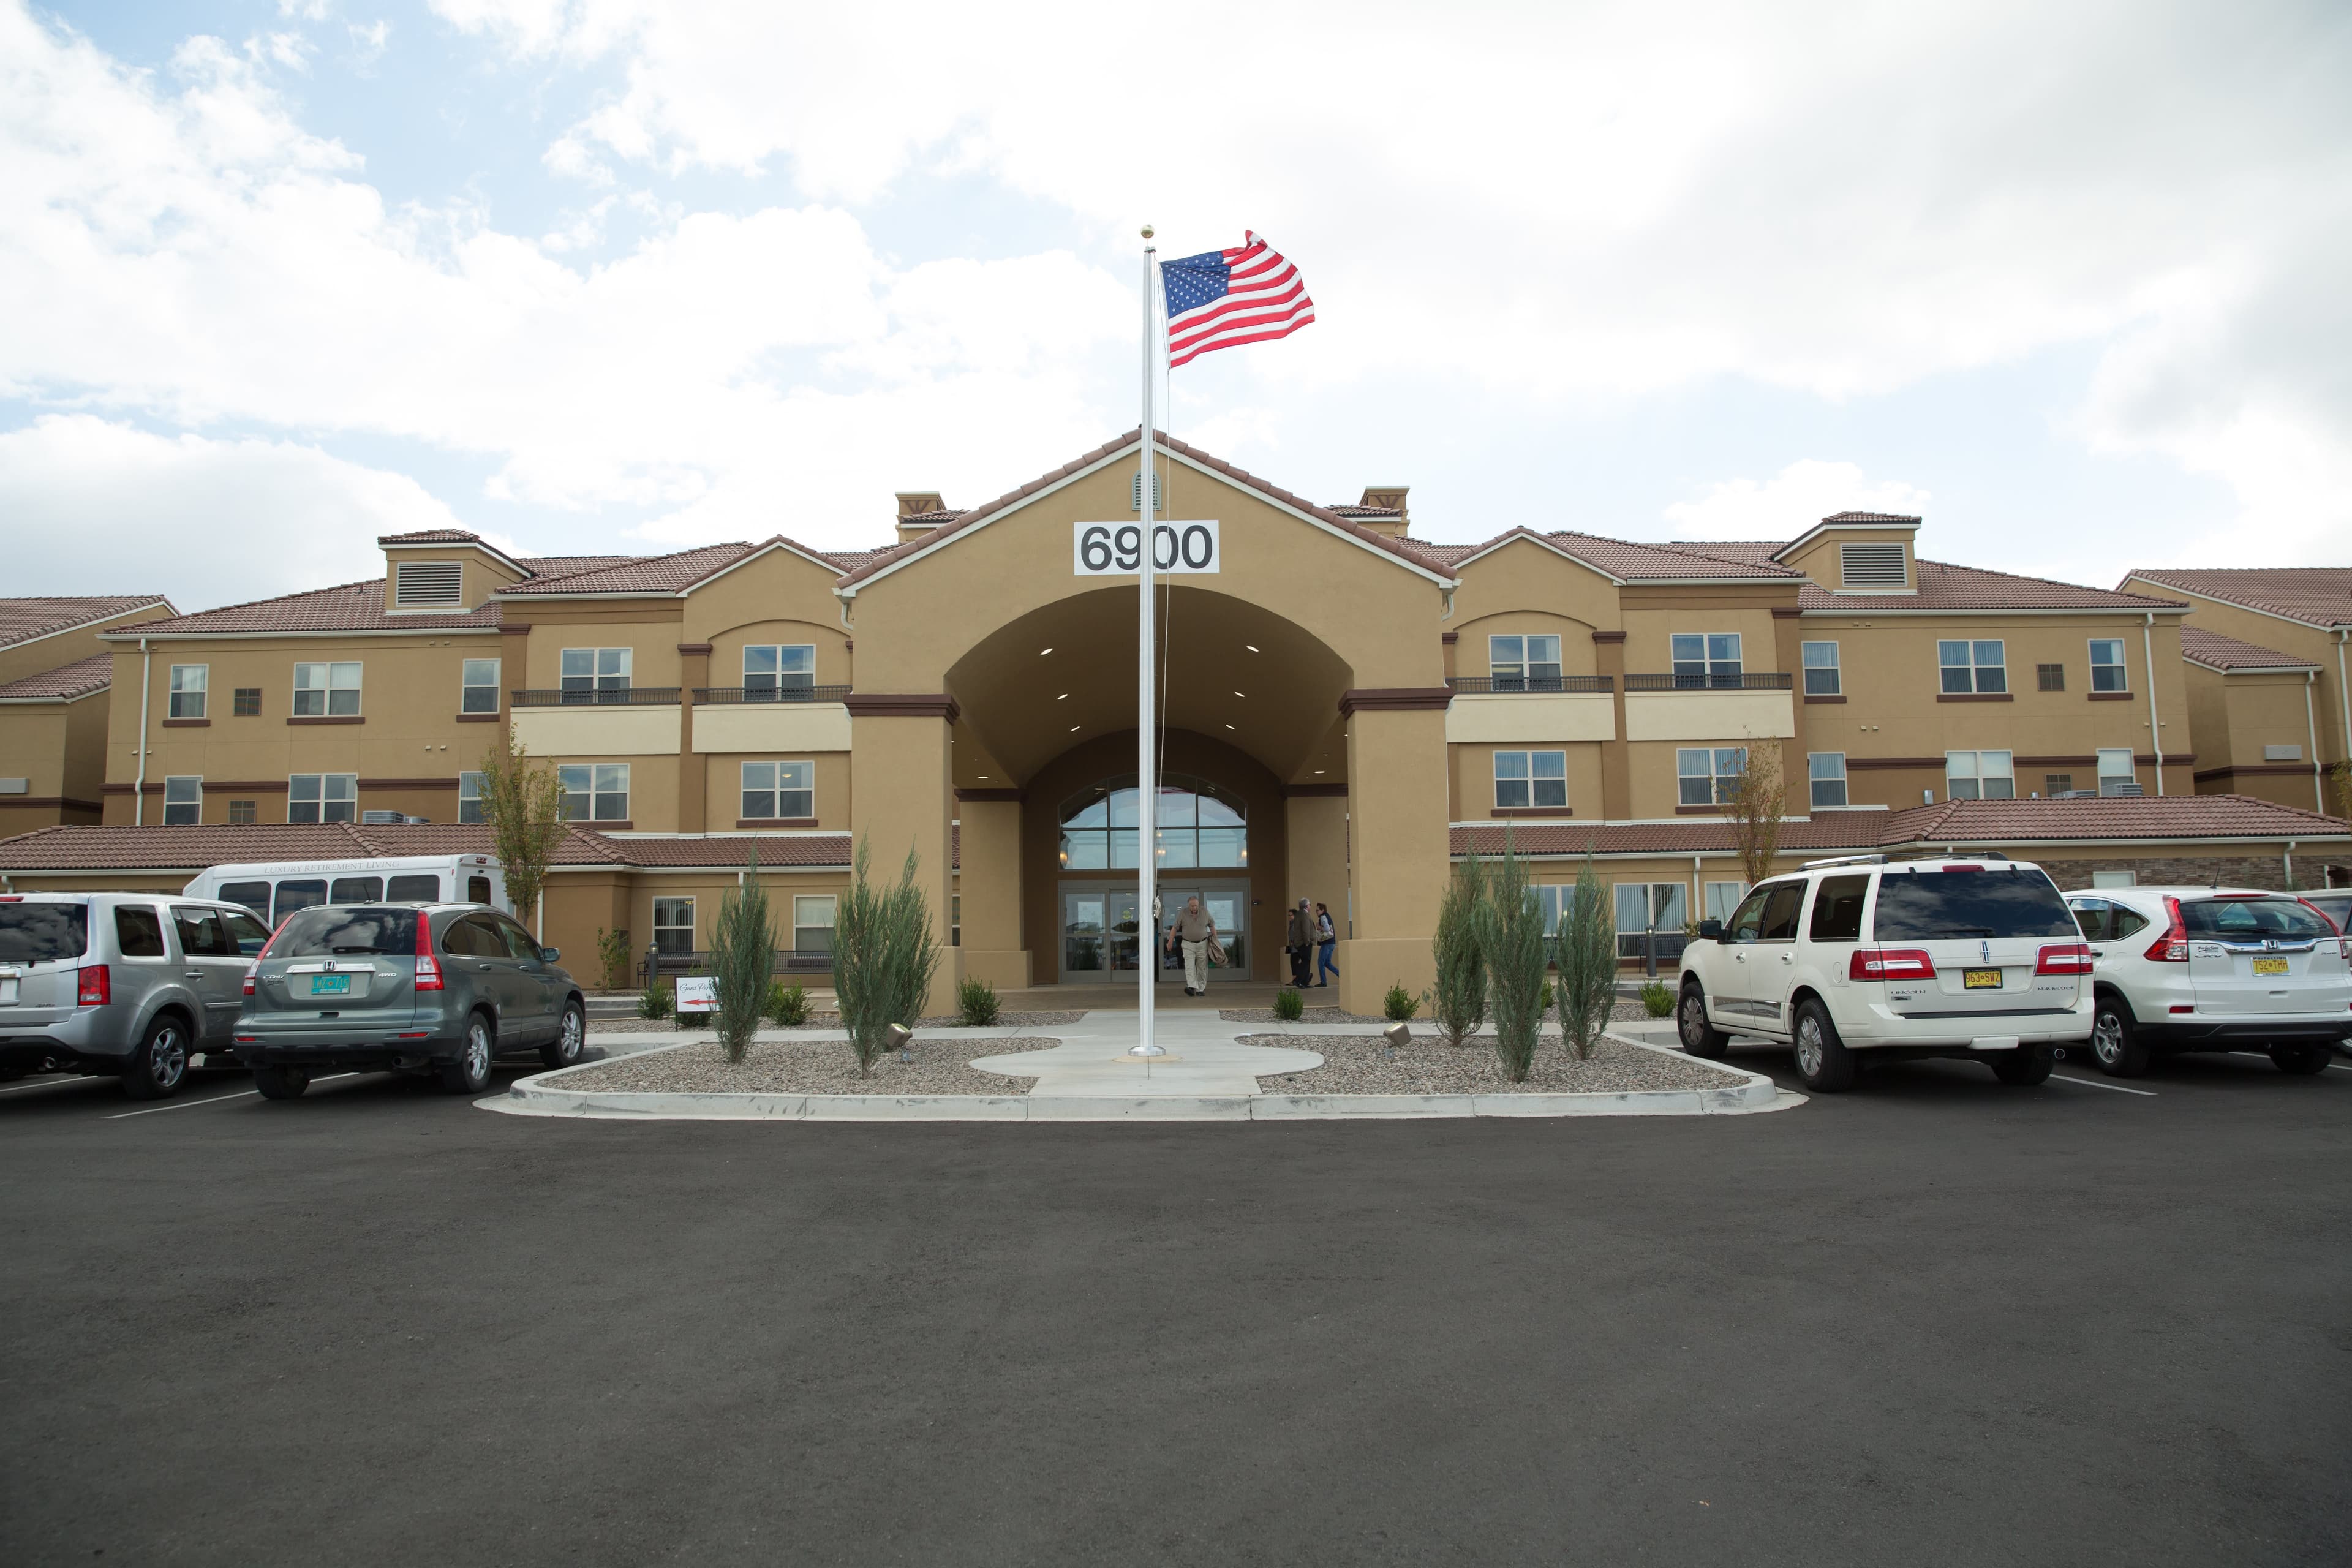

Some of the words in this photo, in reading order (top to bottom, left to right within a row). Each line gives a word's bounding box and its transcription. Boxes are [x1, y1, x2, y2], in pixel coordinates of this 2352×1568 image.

[1080, 524, 1213, 571] 6900
[304, 862, 363, 872] RETIREMENT
[679, 983, 697, 993] Guest
